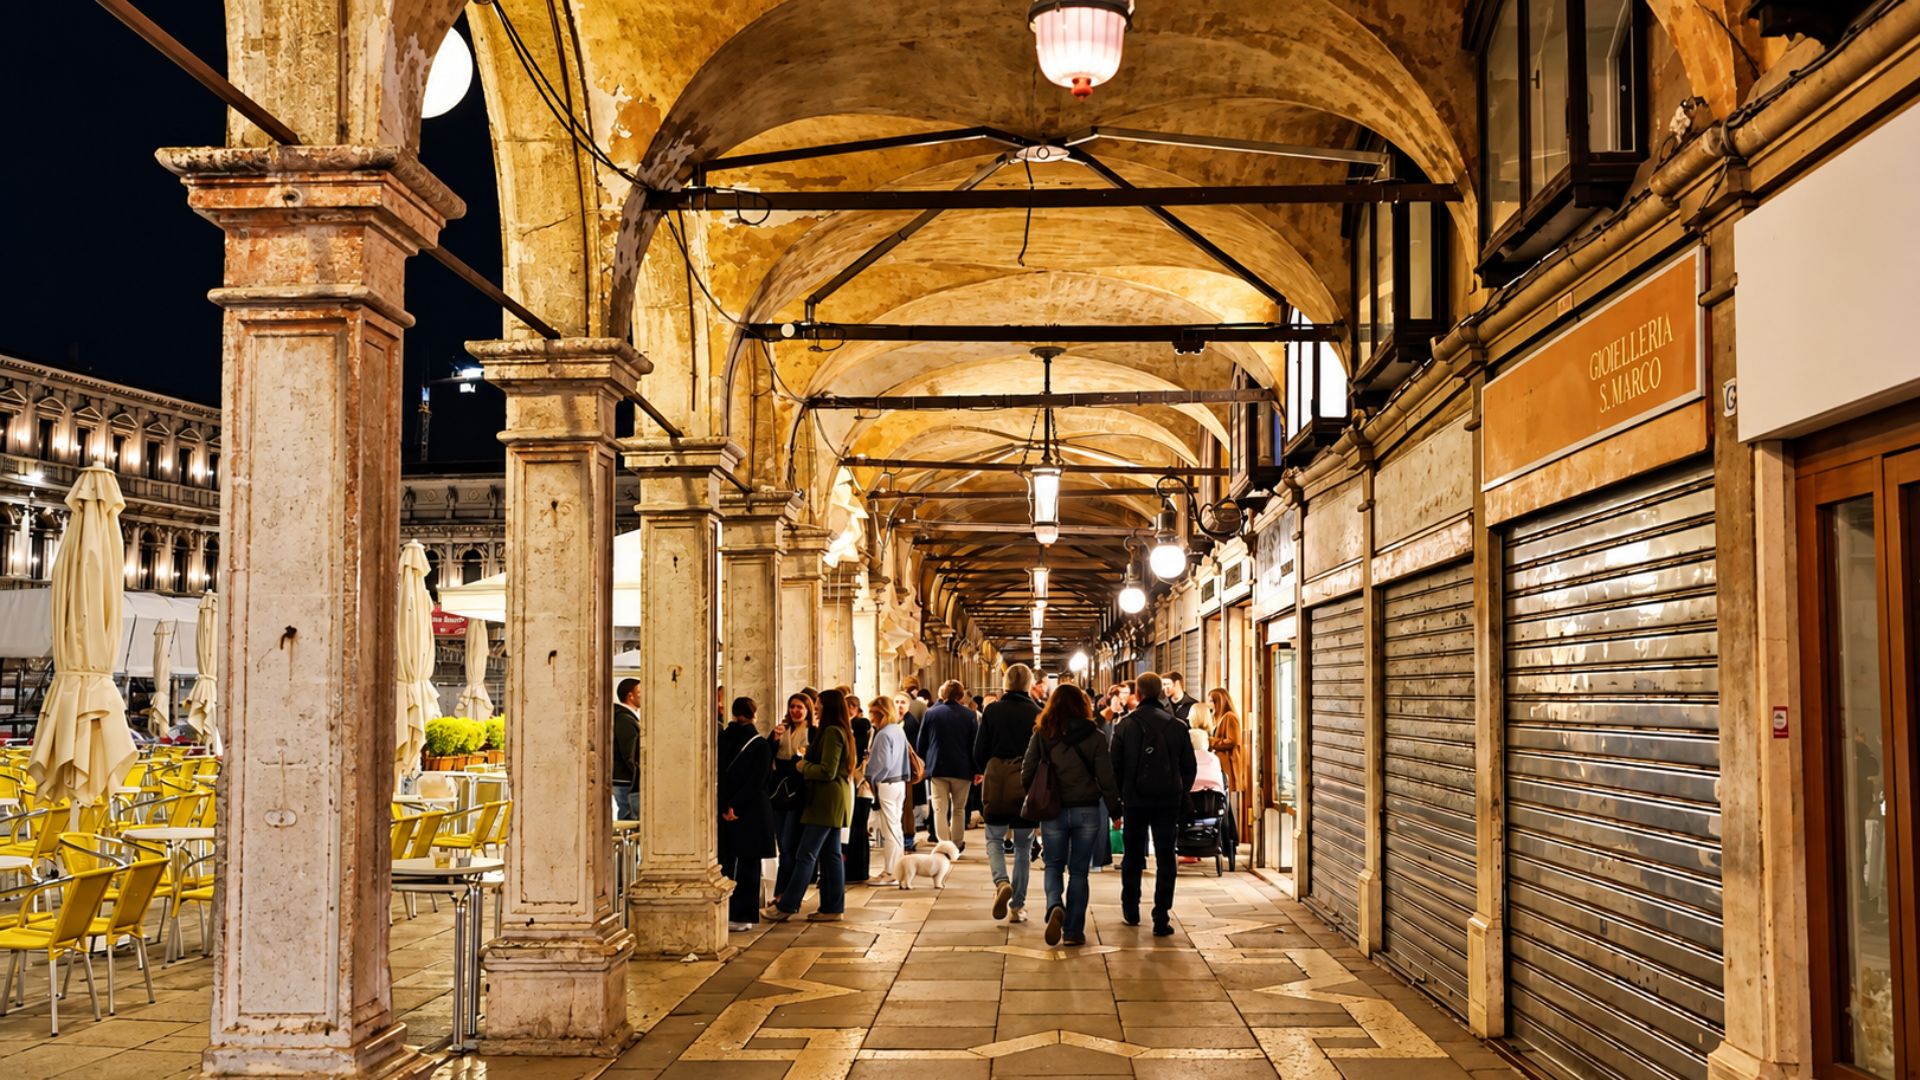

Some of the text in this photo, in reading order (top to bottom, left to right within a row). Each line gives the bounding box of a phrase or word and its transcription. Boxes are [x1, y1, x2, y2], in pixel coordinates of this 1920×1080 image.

[1590, 313, 1673, 381] GIOIELLERIA
[1600, 356, 1661, 414] S. MARCO
